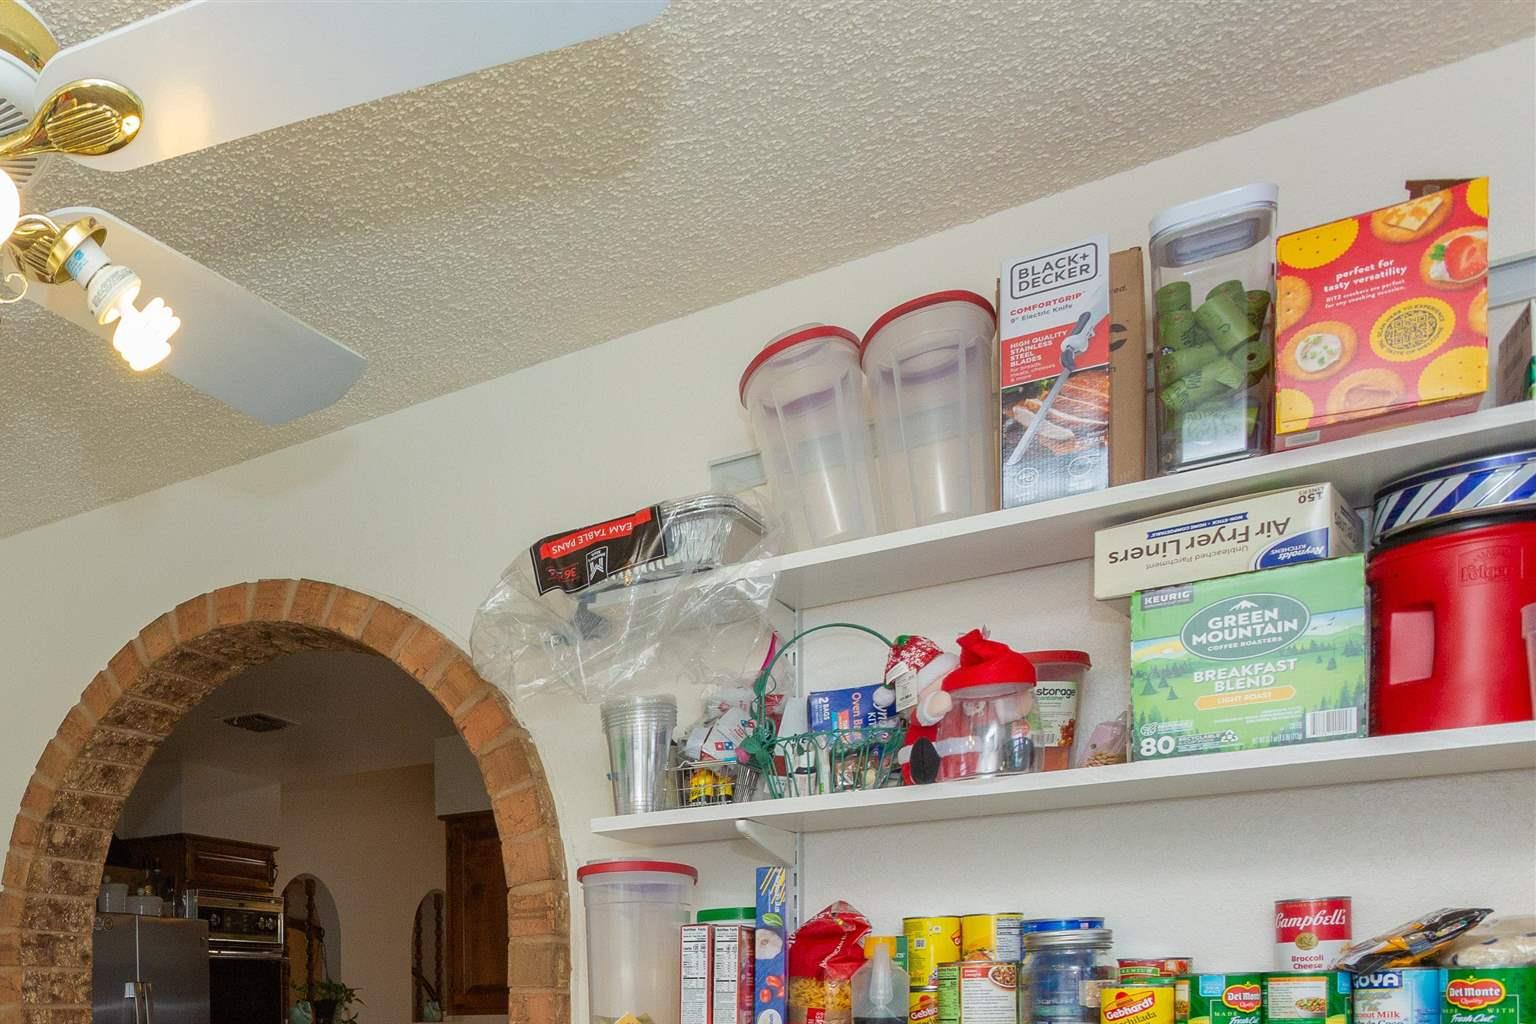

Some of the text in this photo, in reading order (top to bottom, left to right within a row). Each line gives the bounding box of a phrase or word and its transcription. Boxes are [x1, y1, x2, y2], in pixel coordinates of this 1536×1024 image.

[1018, 252, 1090, 280] BLACK+
[1336, 258, 1395, 282] perfect for
[1018, 263, 1091, 292] DECKER
[1324, 266, 1408, 293] tasty versatility
[1021, 303, 1073, 321] Electric Knife
[1010, 330, 1068, 350] HIGH QUALITY
[1010, 340, 1053, 356] STAINLESS
[1010, 351, 1035, 362] STEEL
[1010, 355, 1042, 368] BLADES
[551, 528, 606, 555] TABLE PANS
[1108, 516, 1291, 564] Air Fryer Liners
[1144, 590, 1191, 605] KEURIG
[1207, 607, 1280, 630] GREEN
[1191, 618, 1299, 646] MOUNTAIN
[1207, 636, 1283, 652] COFFEE ROASTERS
[1193, 658, 1297, 684] BREAKFAST
[1214, 674, 1276, 694] BLEND
[818, 695, 829, 705] 2
[850, 692, 862, 718] Oven
[1139, 735, 1176, 757] 80
[1275, 908, 1346, 931] Campbell's
[1291, 954, 1324, 962] Broccoli
[1293, 962, 1323, 970] Cheese
[1449, 986, 1500, 997] Del Monte
[1106, 996, 1154, 1020] Gebhardt
[1377, 1010, 1400, 1018] Milk
